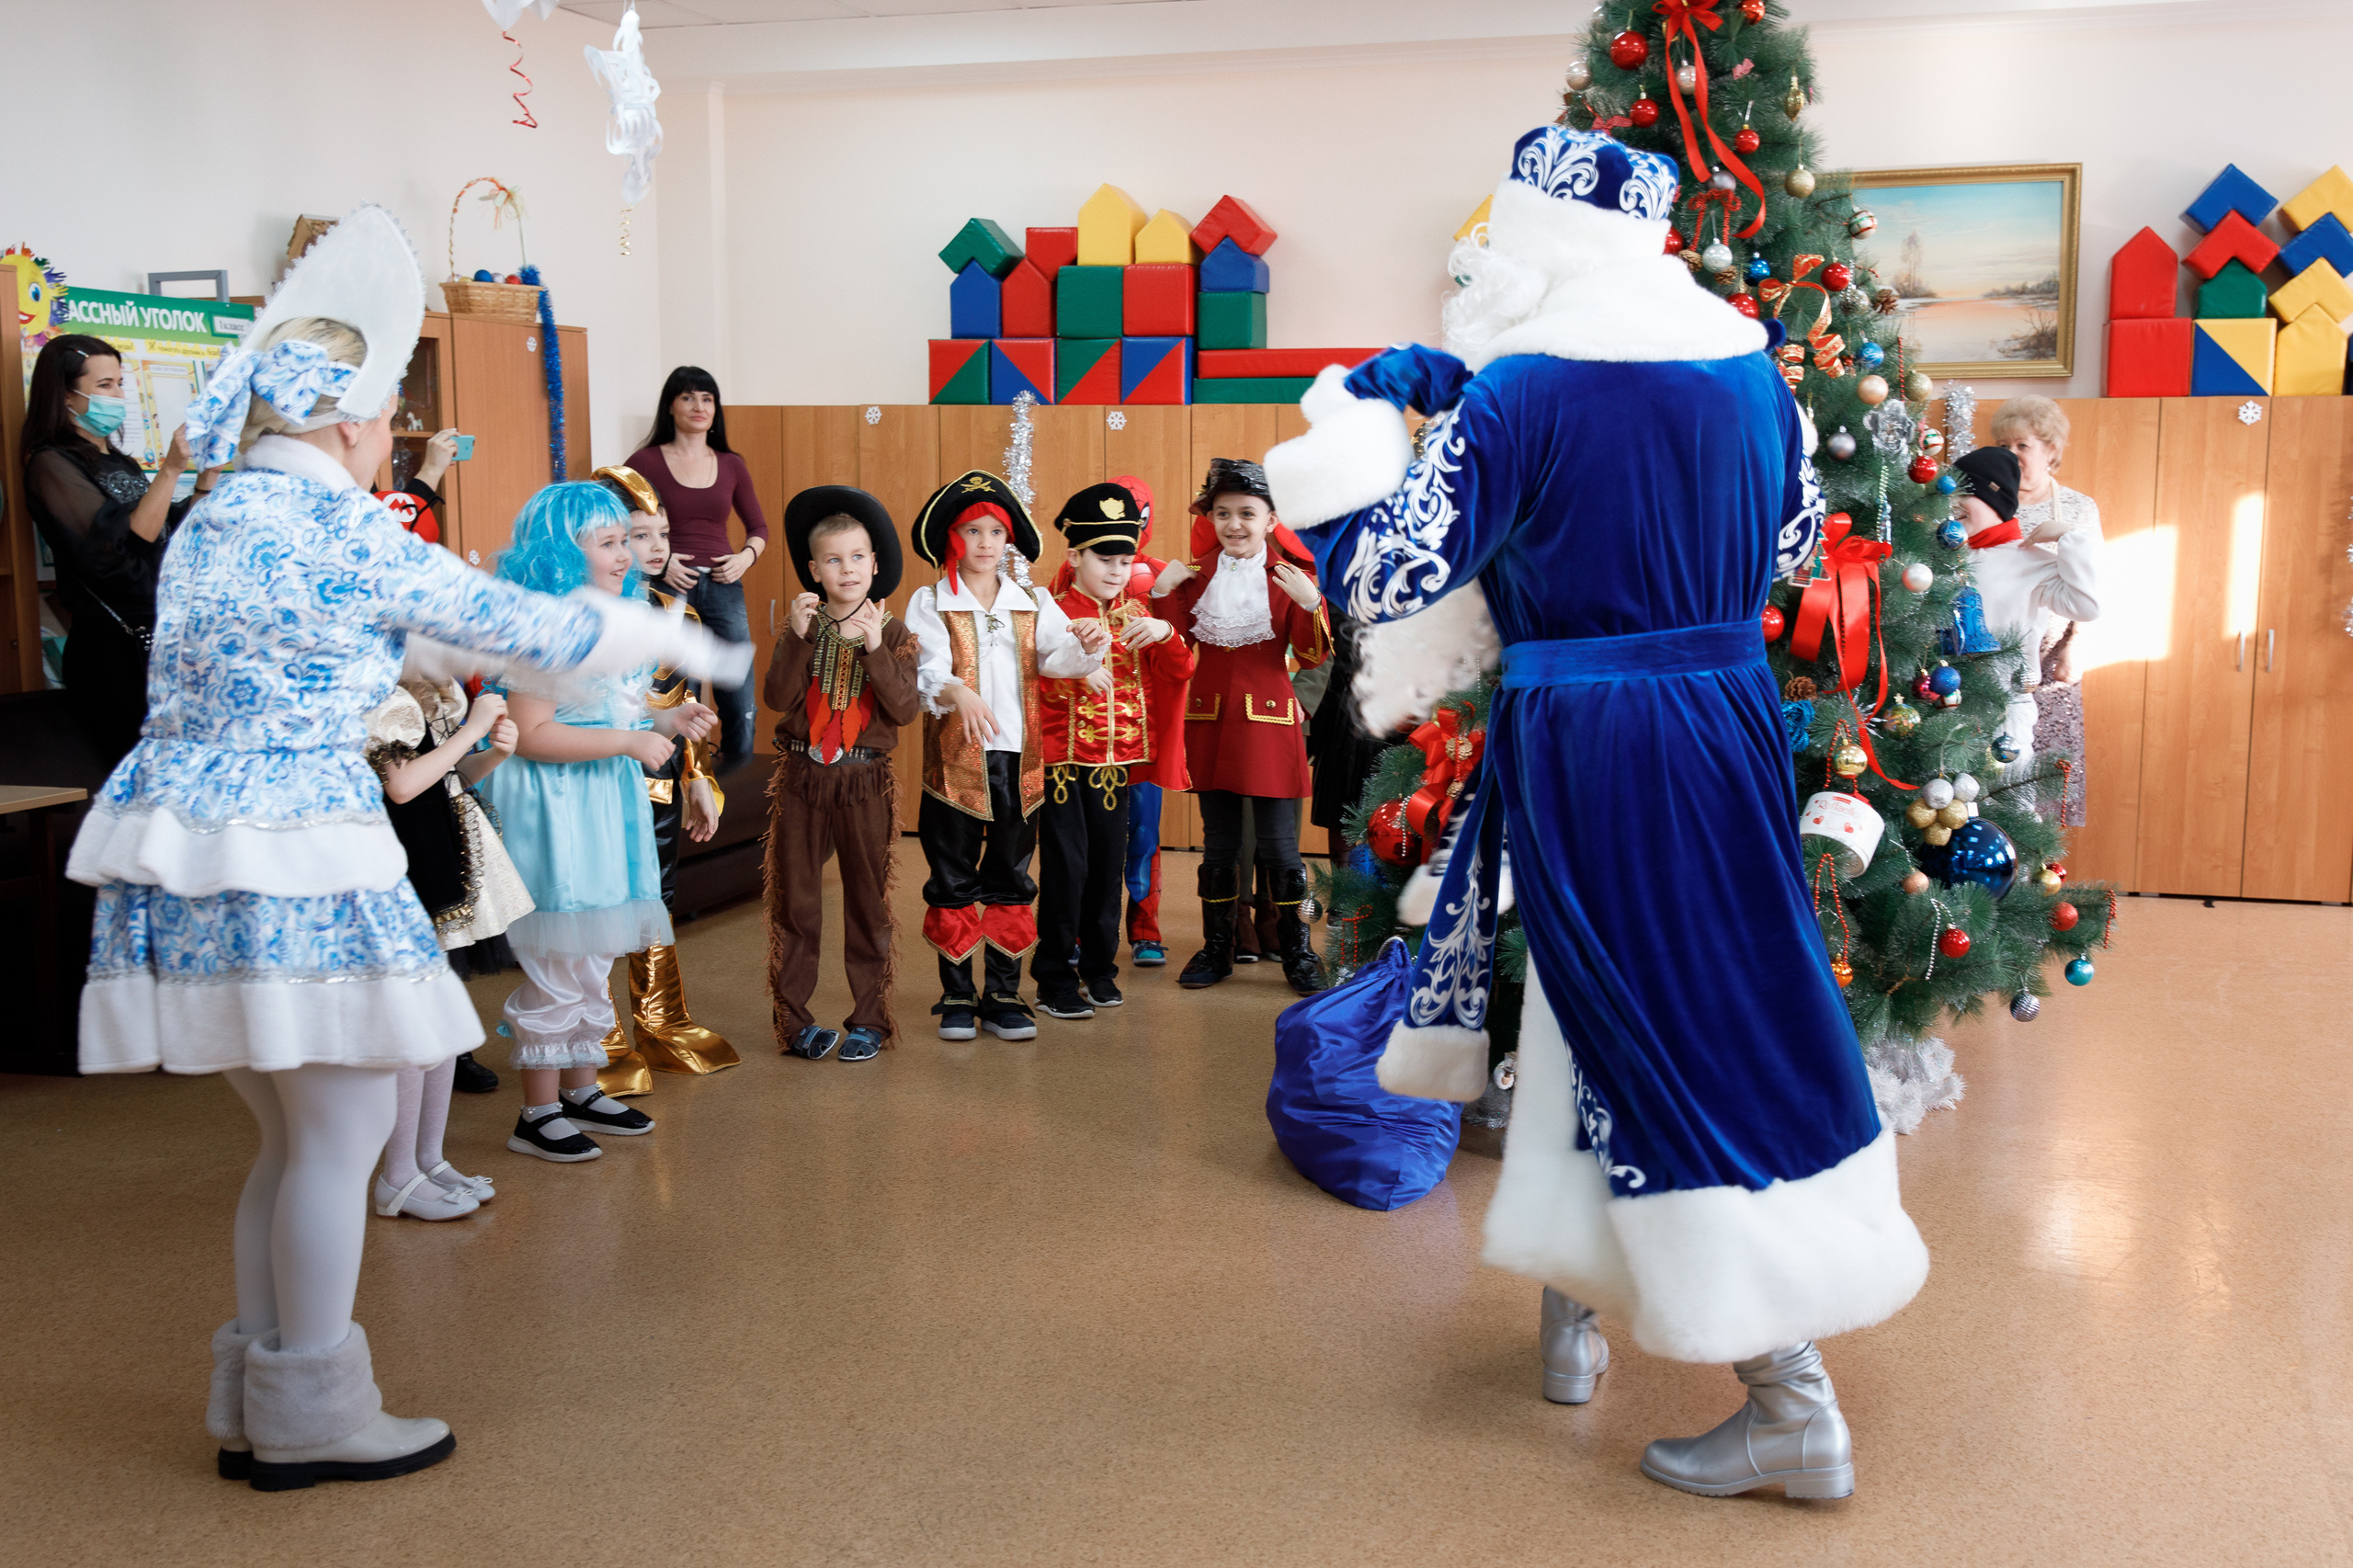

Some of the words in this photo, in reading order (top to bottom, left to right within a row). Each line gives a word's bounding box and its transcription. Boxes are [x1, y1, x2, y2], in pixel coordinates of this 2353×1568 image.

[60, 299, 140, 328] АССНЫЙ
[139, 306, 208, 333] УГОЛОК
[1817, 800, 1859, 819] Raffaello
